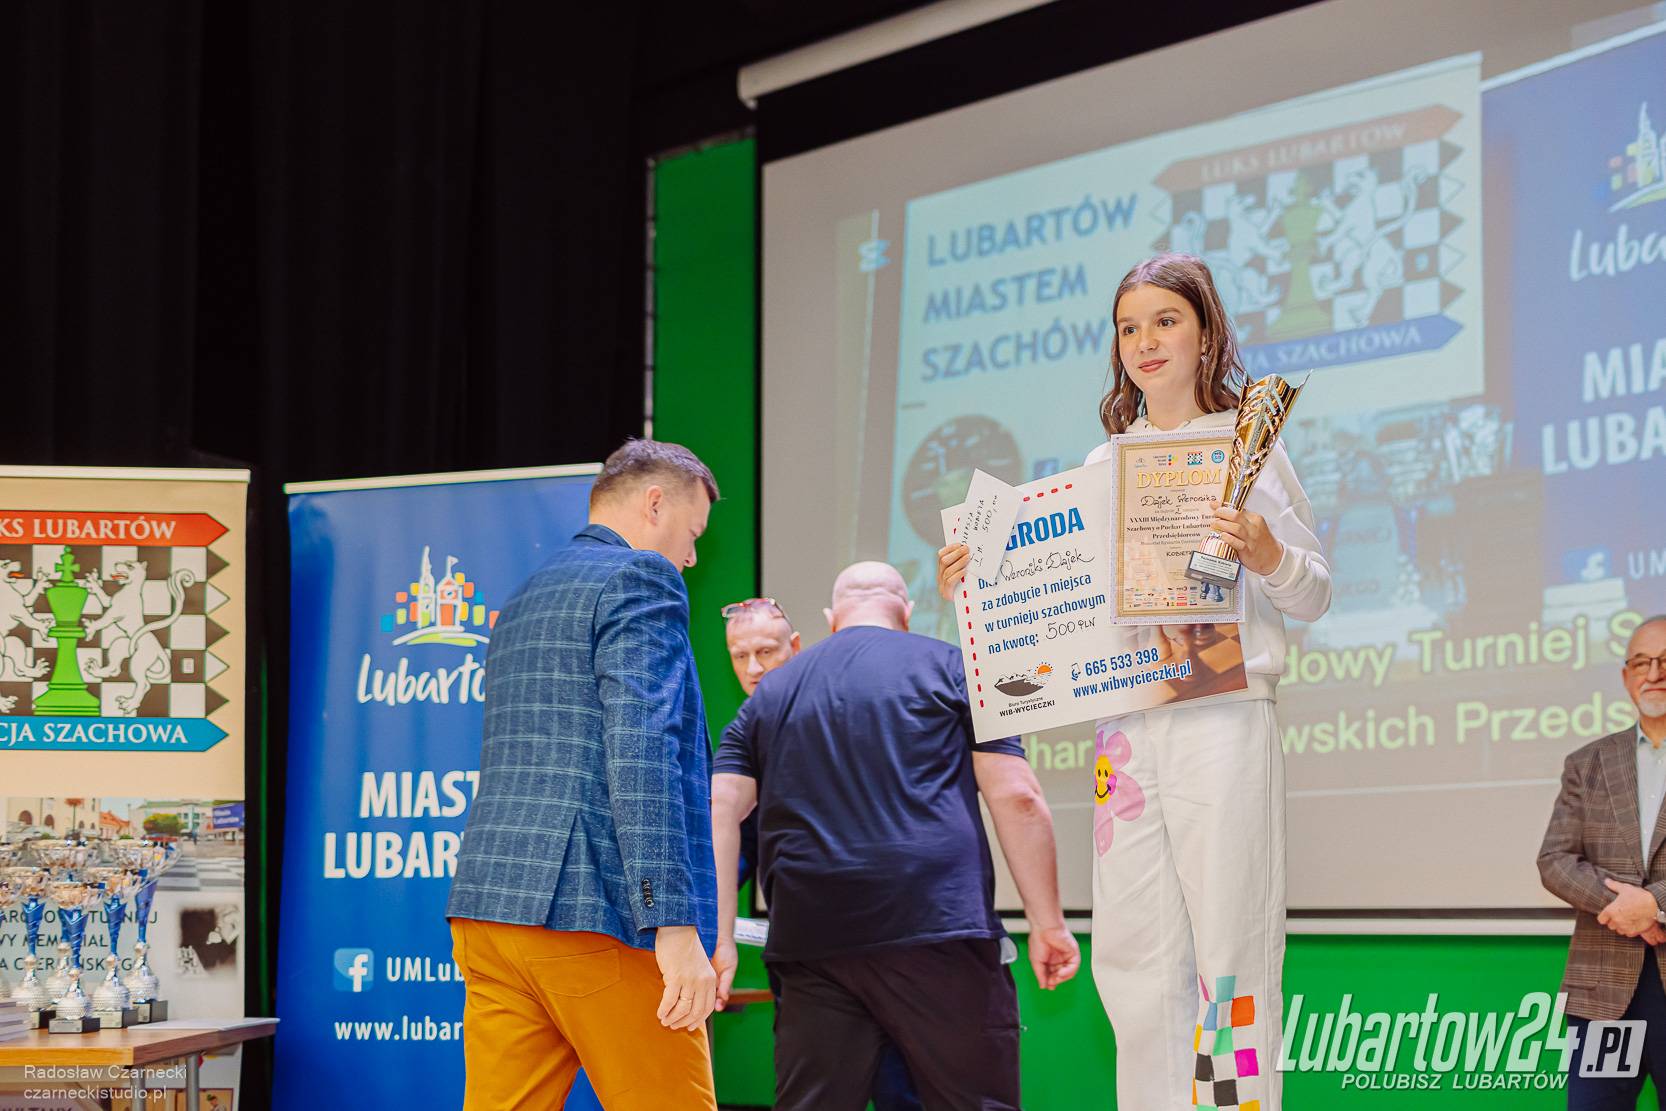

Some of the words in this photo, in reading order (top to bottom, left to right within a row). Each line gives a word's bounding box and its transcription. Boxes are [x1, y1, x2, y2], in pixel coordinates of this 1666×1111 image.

[926, 192, 1138, 268] LUBARTÓW
[923, 263, 1089, 324] MIASTEM
[920, 316, 1108, 383] SZACHÓW
[1278, 326, 1422, 362] SZACHOWA
[1136, 468, 1222, 489] DYPLOM
[33, 516, 176, 539] LUBARTÓW
[982, 600, 993, 612] za
[996, 586, 1041, 608] zdobycie
[1050, 574, 1092, 594] miejsca
[985, 622, 994, 633] w
[997, 609, 1039, 630] turnieju
[1041, 594, 1106, 619] szachowym
[1046, 621, 1076, 640] 500
[988, 643, 1001, 655] na
[1003, 633, 1039, 651] kwotę:
[1085, 659, 1108, 677] 665
[1110, 653, 1133, 671] 533
[1136, 647, 1160, 666] 398
[1408, 616, 1588, 673] Turniej
[1072, 659, 1192, 698] www.wibwycieczki.pl
[999, 699, 1056, 717] WIB-WYCIECZKI
[1456, 691, 1638, 744] Przeds
[43, 722, 188, 744] SZACHOWA
[323, 831, 465, 879] LUBAR
[334, 1015, 464, 1041] www.lubar
